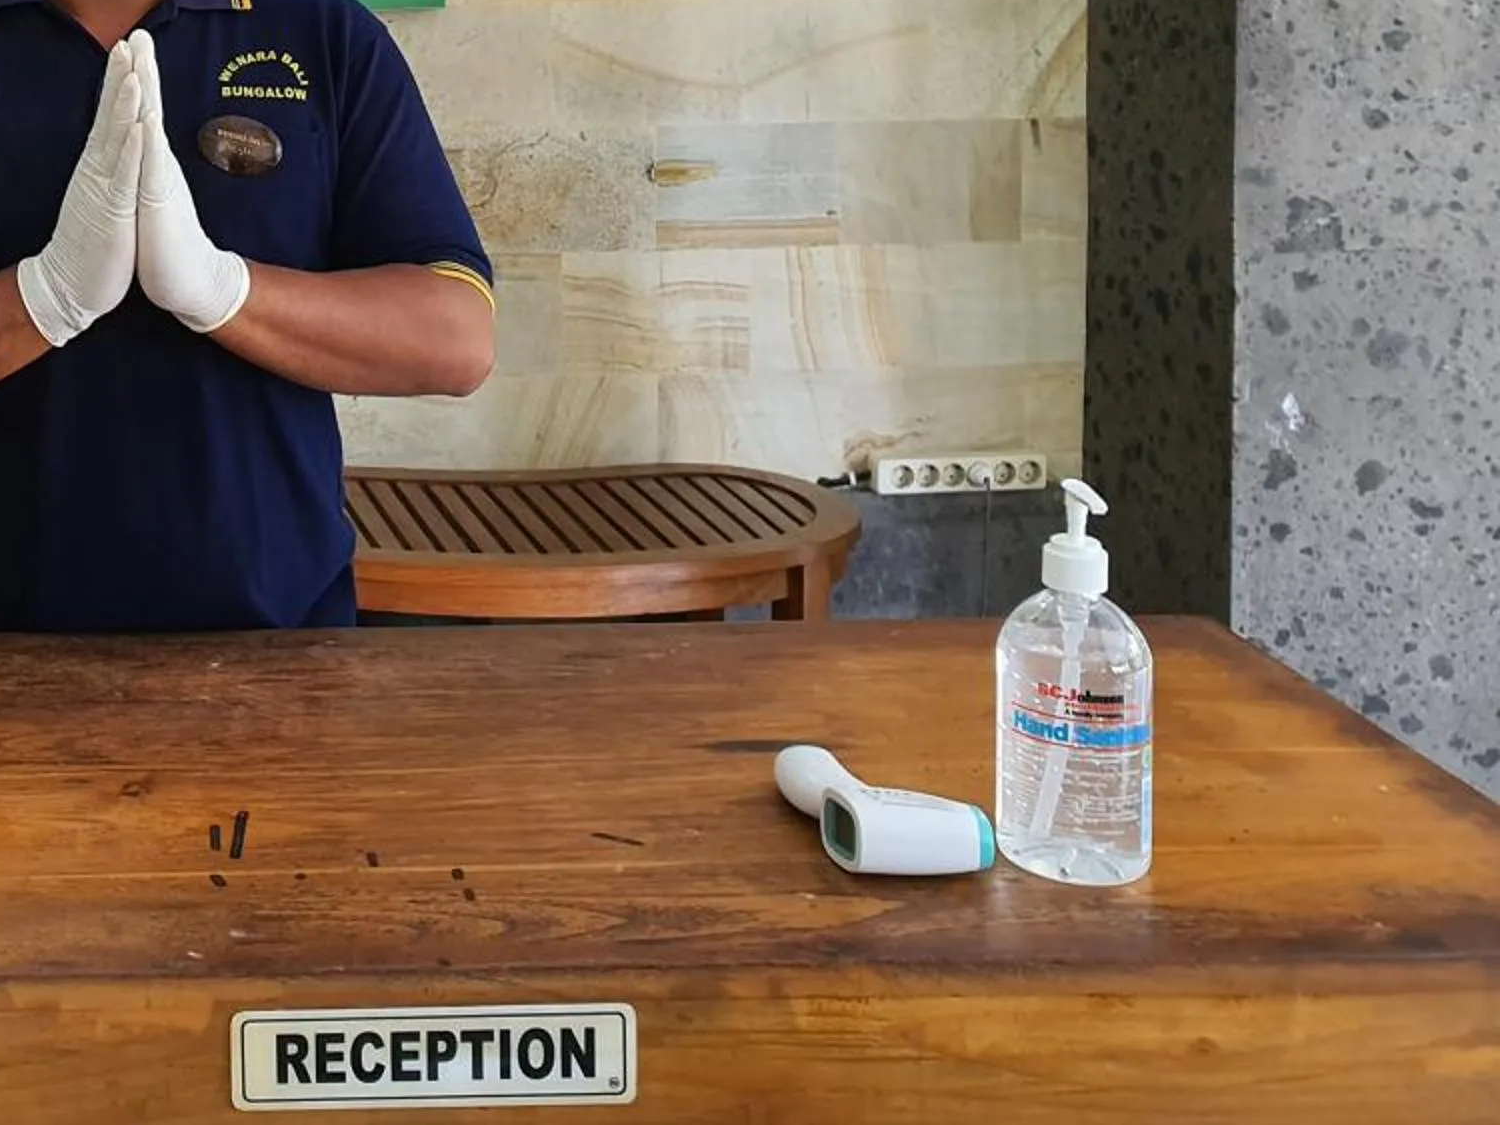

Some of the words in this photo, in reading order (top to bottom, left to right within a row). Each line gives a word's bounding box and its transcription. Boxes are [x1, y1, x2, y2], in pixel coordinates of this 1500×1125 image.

[281, 52, 309, 86] BALI
[221, 86, 307, 101] BUNGALOW
[1014, 709, 1069, 742] Hand
[276, 1028, 596, 1084] RECEPTION
